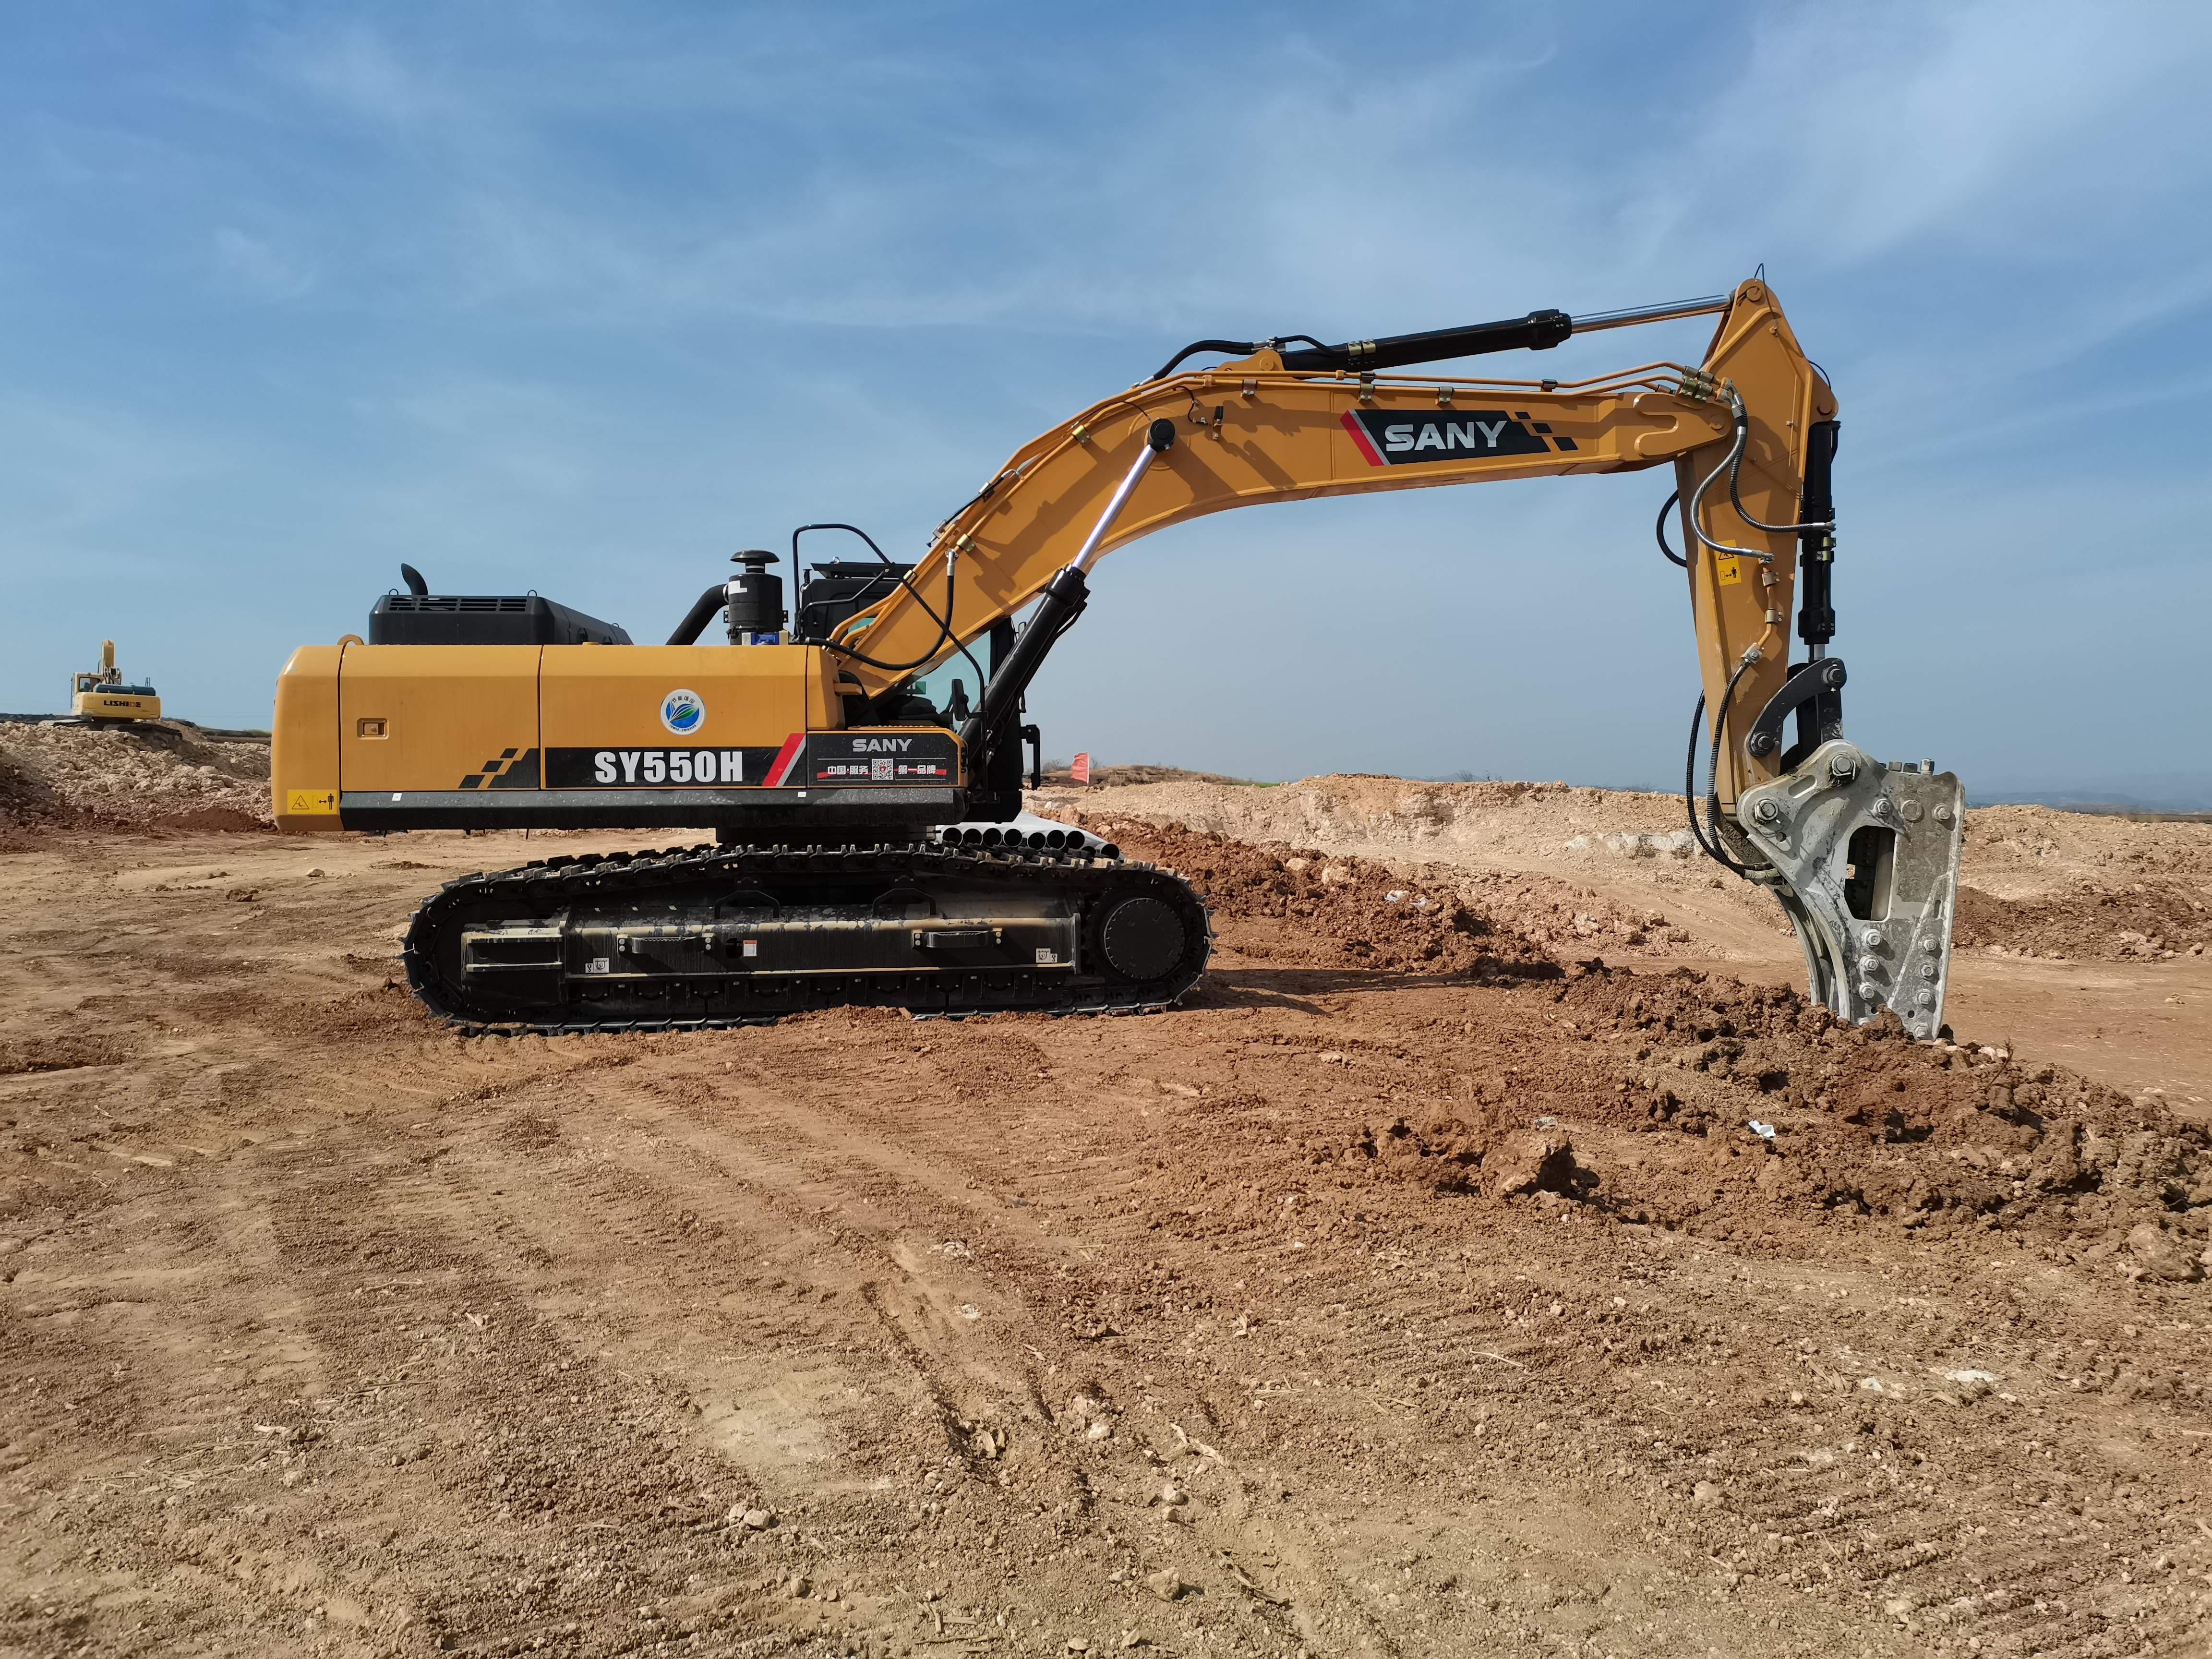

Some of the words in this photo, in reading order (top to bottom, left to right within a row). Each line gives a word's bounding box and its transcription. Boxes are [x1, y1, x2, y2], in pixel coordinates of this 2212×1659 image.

[1385, 420, 1507, 452] SANY
[852, 738, 913, 752] SANY
[594, 751, 743, 783] SY550H
